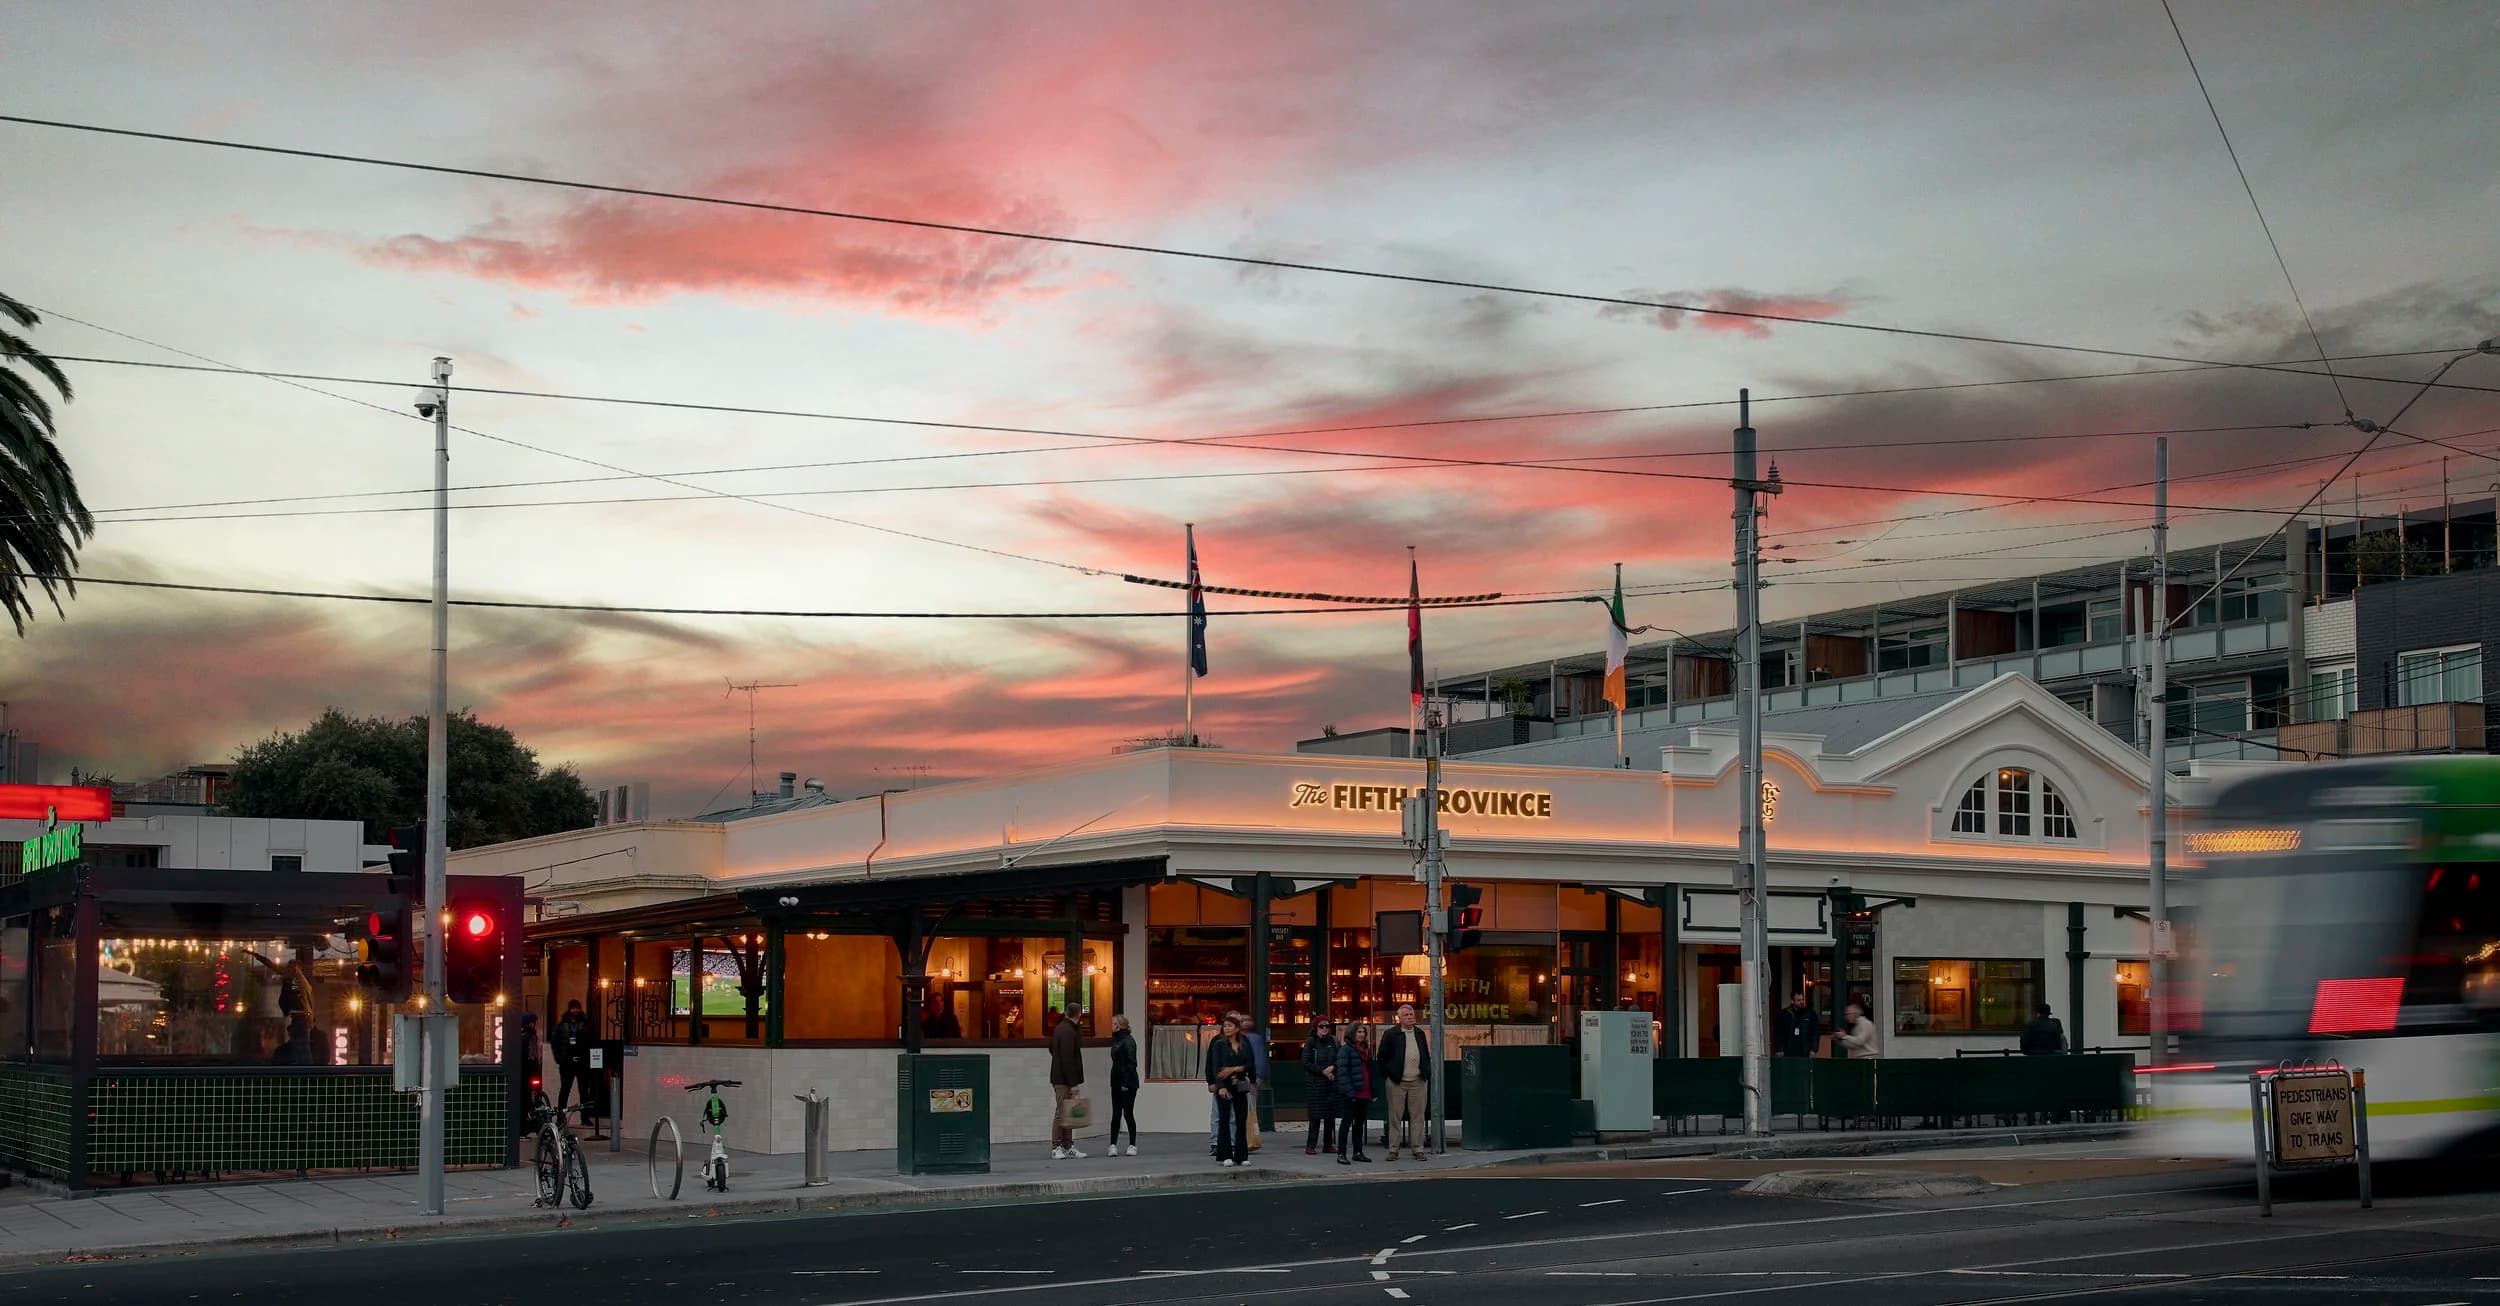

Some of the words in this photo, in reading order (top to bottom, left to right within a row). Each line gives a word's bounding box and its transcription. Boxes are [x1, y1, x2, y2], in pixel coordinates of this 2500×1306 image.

[1292, 784, 1328, 806] The
[1334, 785, 1407, 811] FIFTH
[1416, 788, 1551, 817] ROVINCE
[42, 823, 80, 869] PROVINCE
[1423, 1003, 1509, 1019] POVINCE
[2280, 1088, 2346, 1104] PEDESTRIANS
[2290, 1111, 2312, 1126] GIVE
[2316, 1110, 2339, 1124] WAY
[2290, 1134, 2303, 1148] TO
[2307, 1131, 2343, 1147] TRAMS
